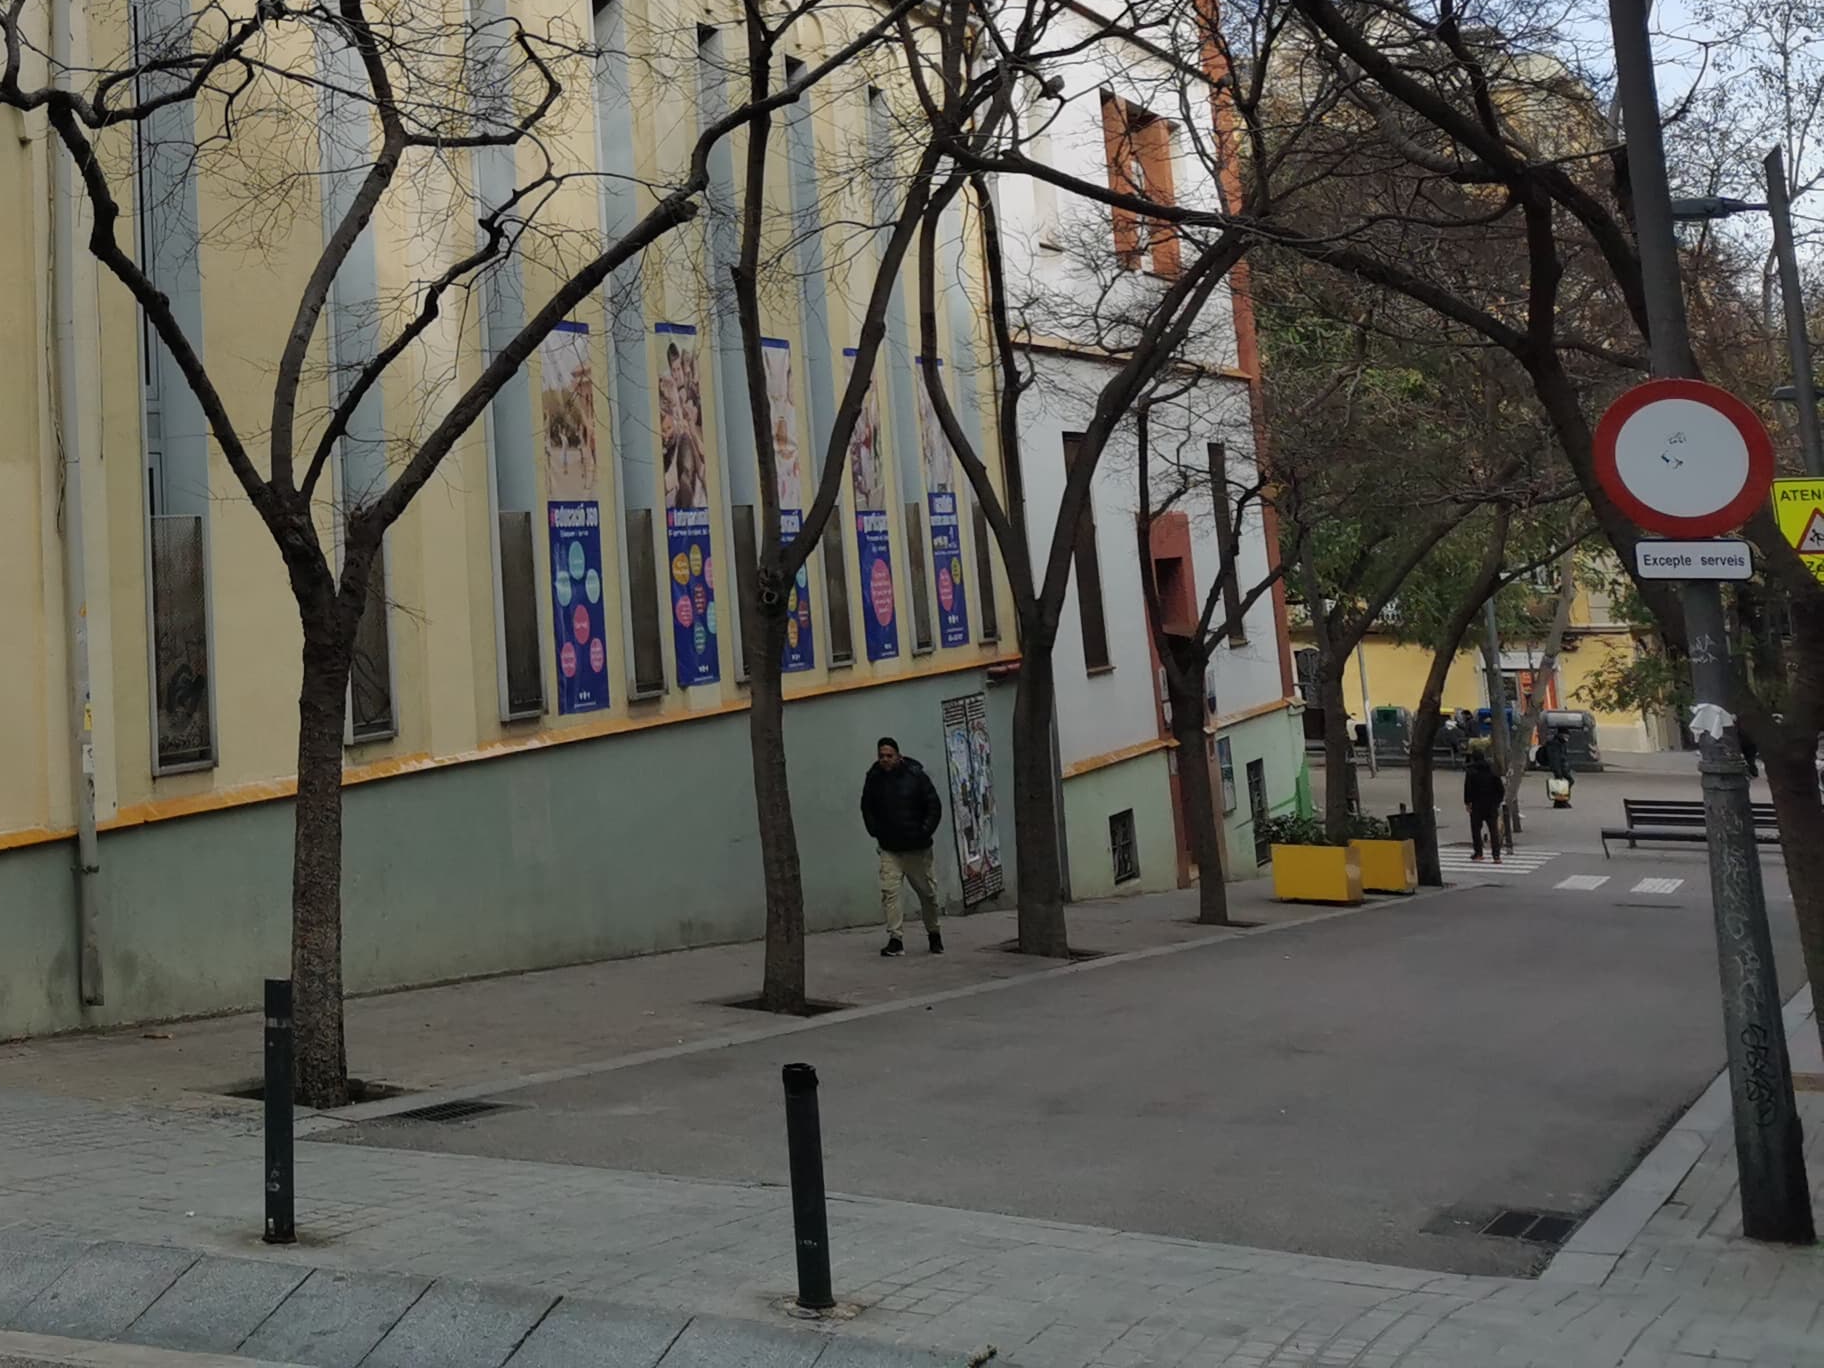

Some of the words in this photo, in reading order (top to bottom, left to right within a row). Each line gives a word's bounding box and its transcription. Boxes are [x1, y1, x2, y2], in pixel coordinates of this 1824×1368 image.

[1780, 488, 1824, 501] ATEN
[1643, 554, 1692, 569] Excepte
[1700, 554, 1745, 567] serveis
